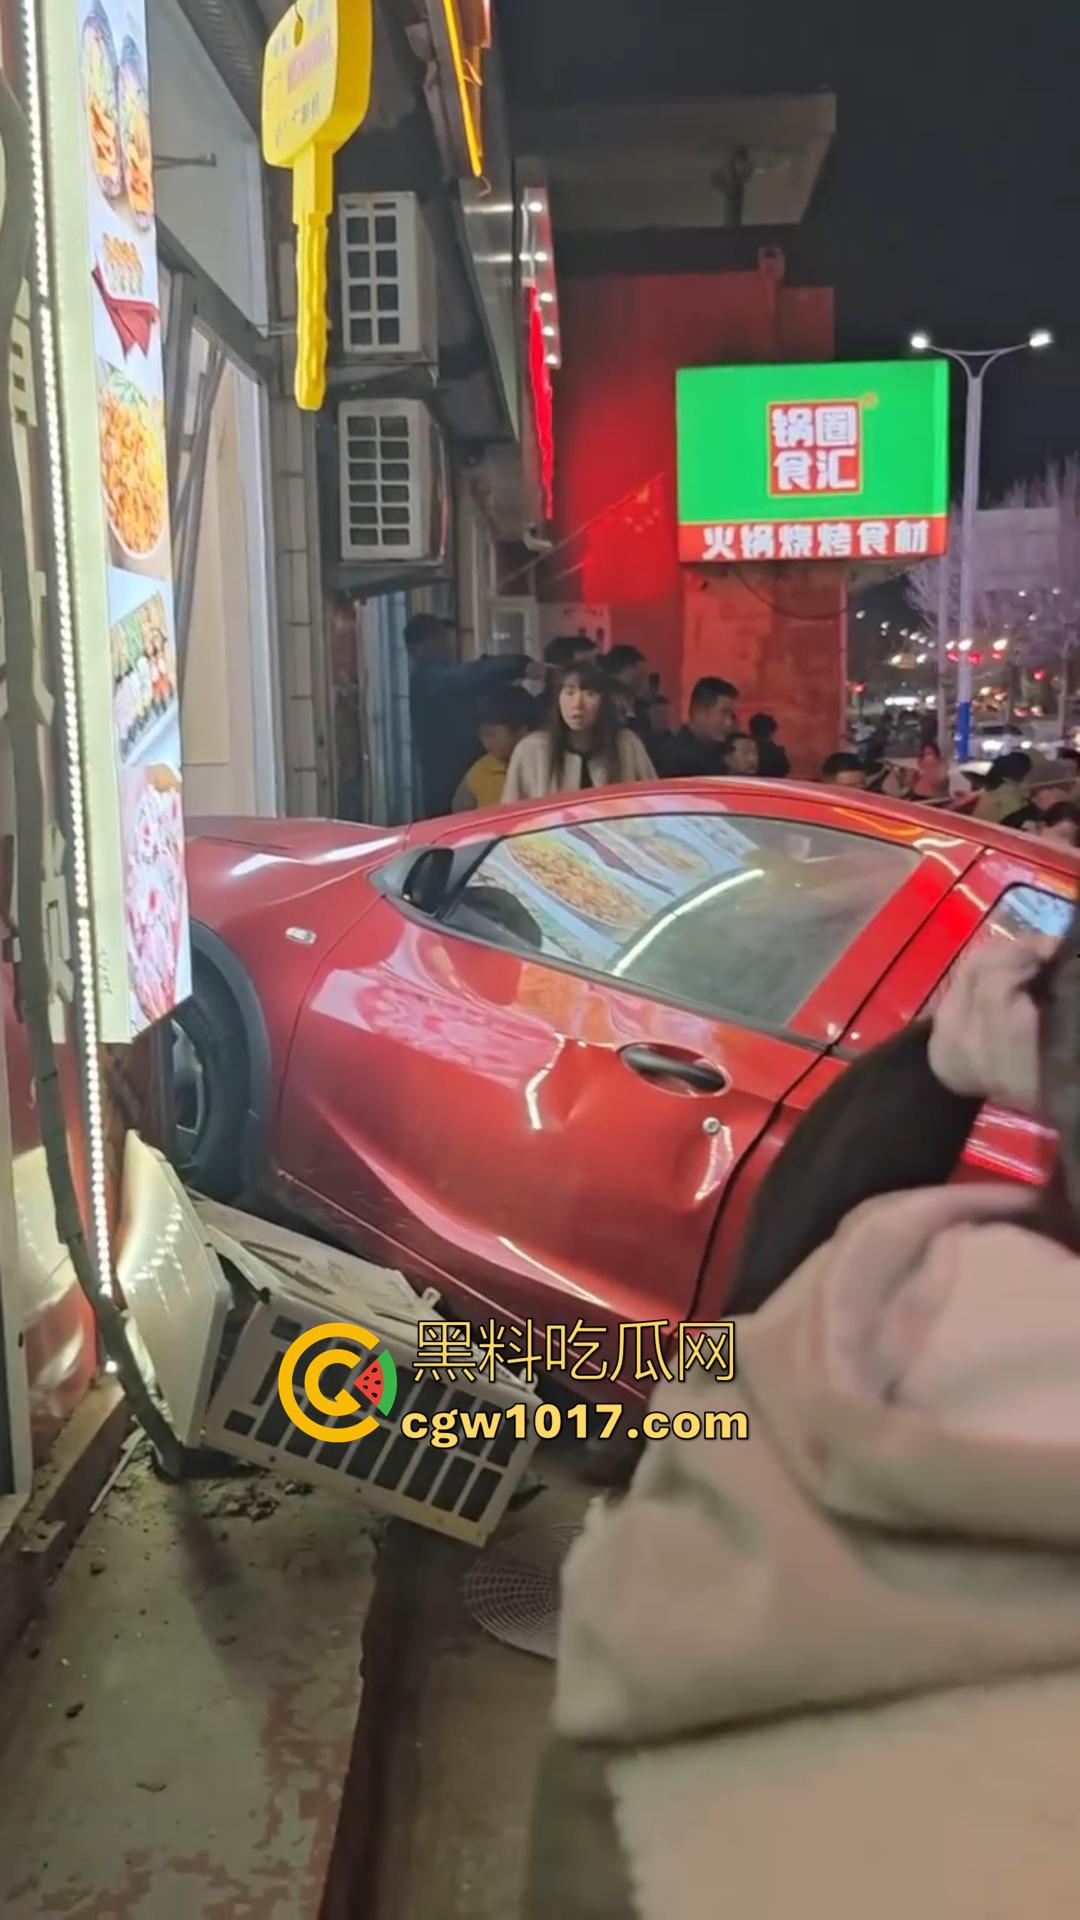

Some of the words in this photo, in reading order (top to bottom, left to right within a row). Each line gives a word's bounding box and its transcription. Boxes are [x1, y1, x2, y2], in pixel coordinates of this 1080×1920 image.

[772, 406, 857, 447] 锅圈
[774, 448, 857, 490] 食汇
[703, 520, 929, 560] 火锅烧烤食材
